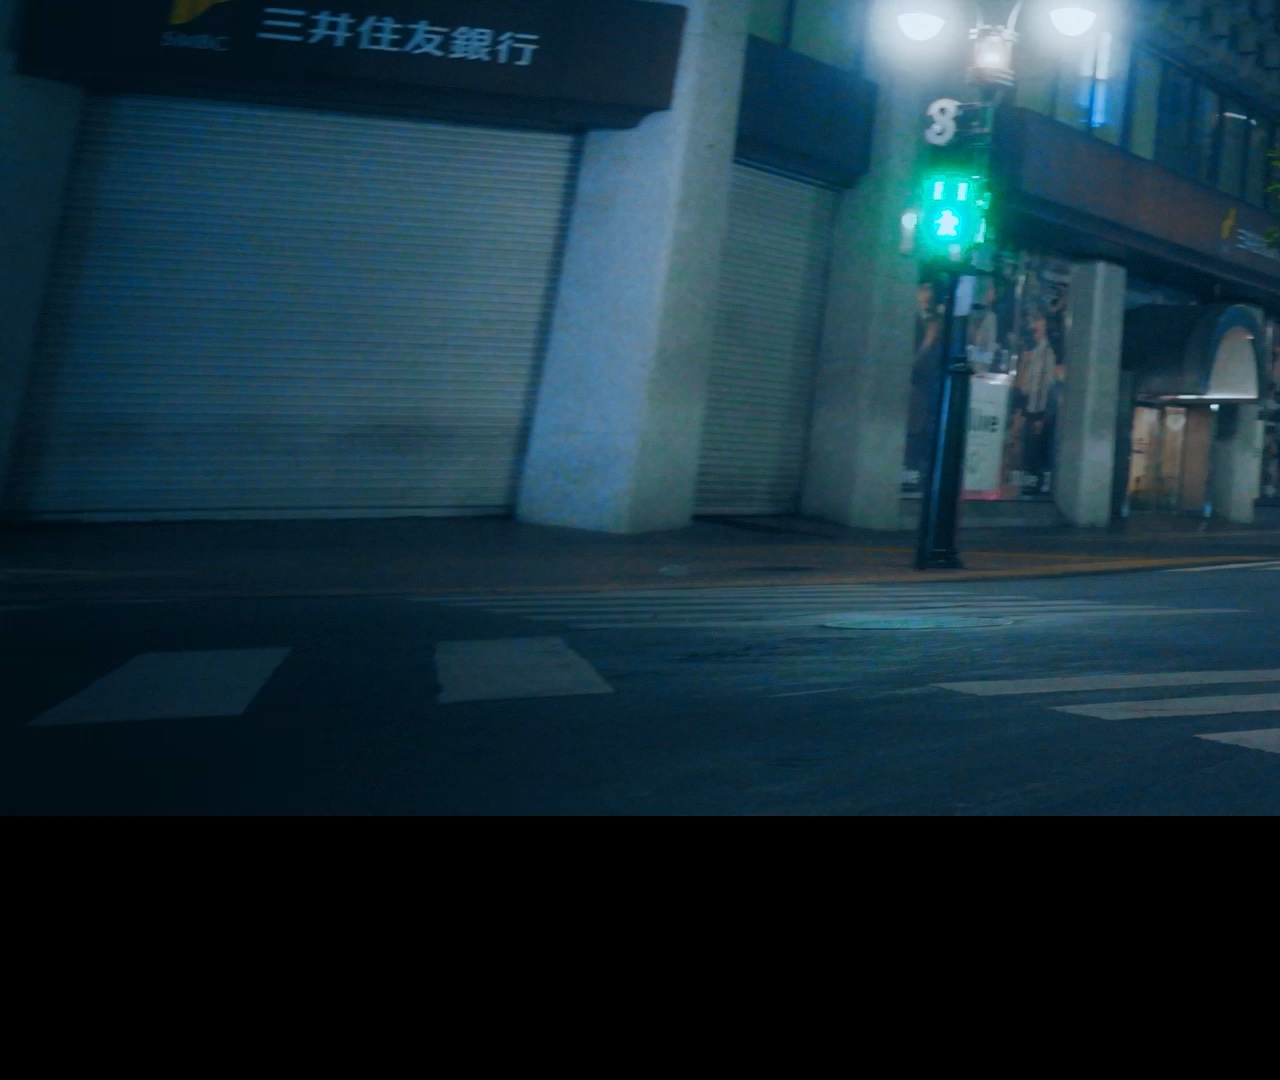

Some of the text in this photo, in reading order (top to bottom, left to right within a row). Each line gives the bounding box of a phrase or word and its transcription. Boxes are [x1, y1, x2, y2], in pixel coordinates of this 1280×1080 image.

[256, 6, 541, 66] 三井住友銀行
